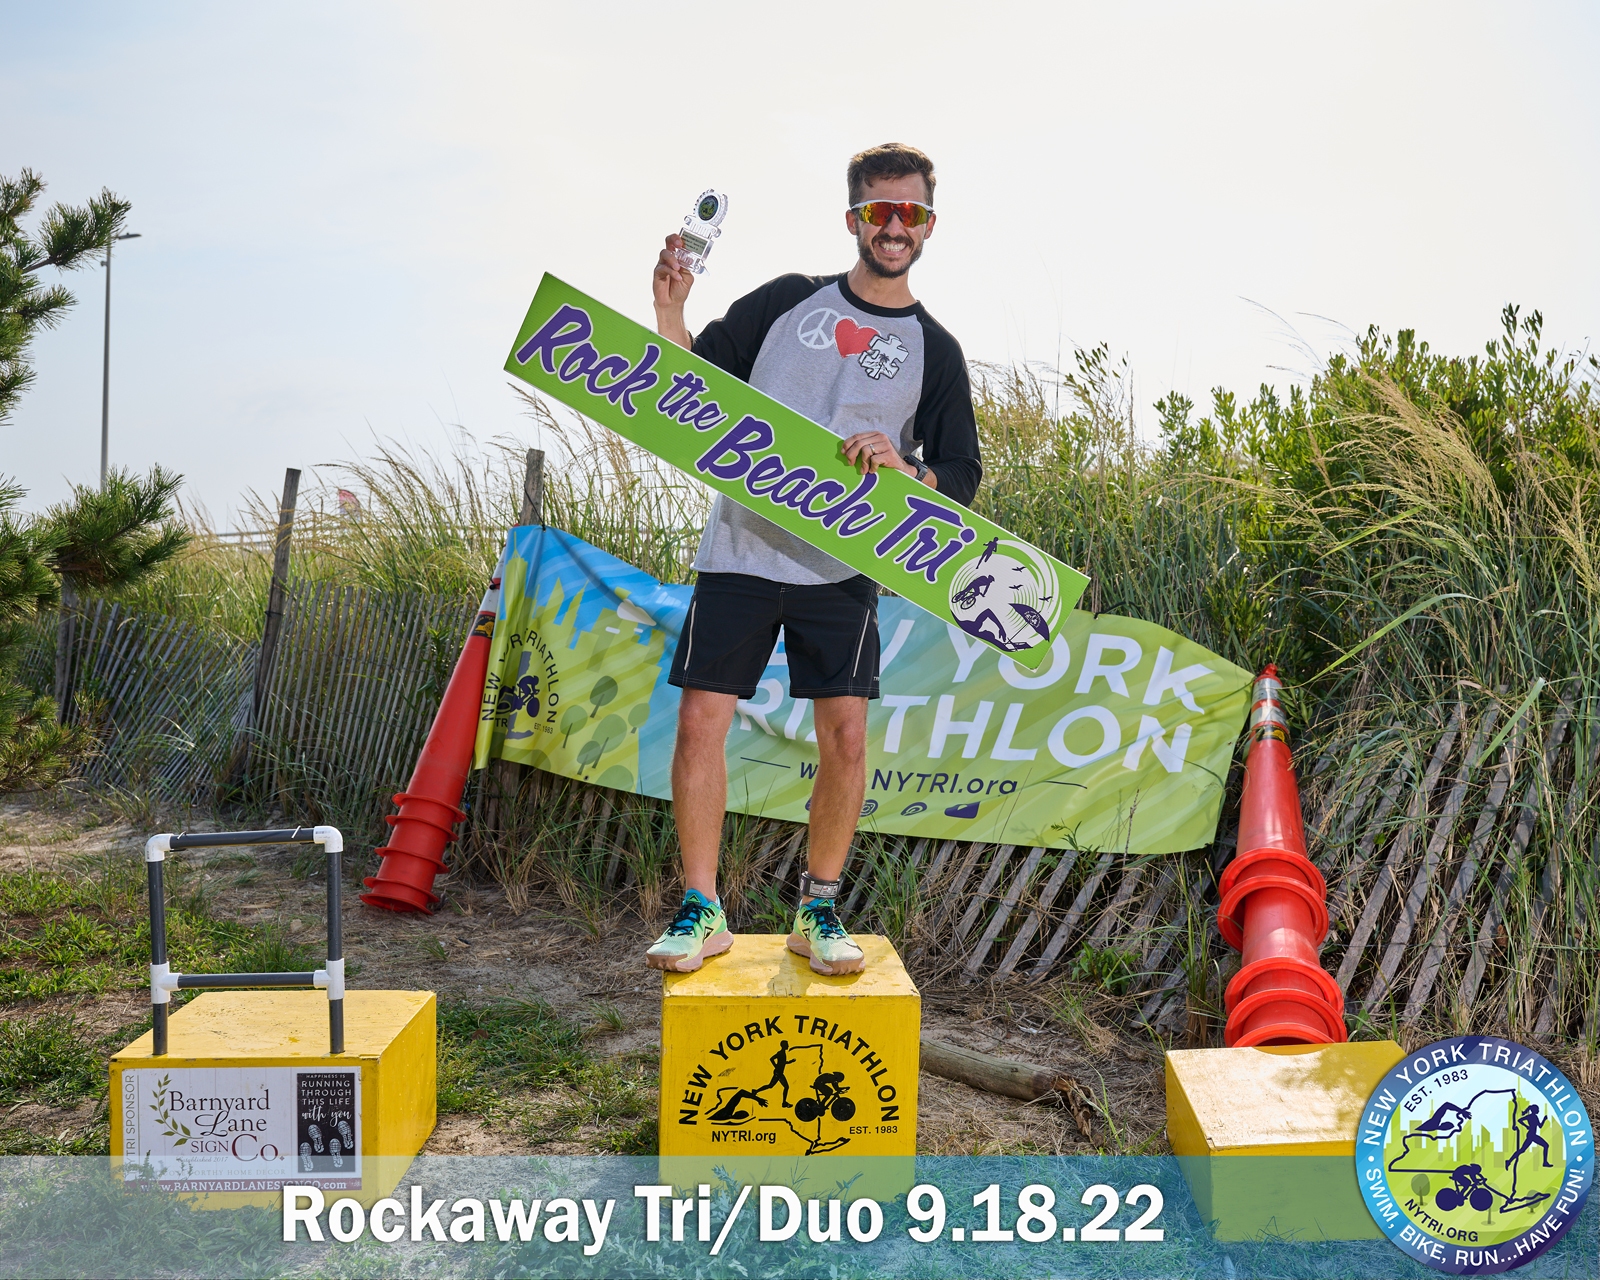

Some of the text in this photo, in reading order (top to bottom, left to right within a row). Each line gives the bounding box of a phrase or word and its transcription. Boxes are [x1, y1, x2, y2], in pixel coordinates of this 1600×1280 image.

[516, 303, 977, 584] Rock the Beach Tri
[482, 672, 501, 721] NEW
[525, 628, 560, 723] RIATHLON
[737, 678, 1192, 773] RITHLON
[678, 1014, 900, 1125] NEW YORK TRIATHLON
[301, 1080, 351, 1088] RUNNING
[301, 1089, 352, 1097] THROUGH
[125, 1075, 136, 1134] SPONSOR
[168, 1089, 271, 1114] Barnyard
[302, 1098, 350, 1106] THIS LIFE
[194, 1110, 267, 1137] Lane
[301, 1105, 352, 1128] with you
[711, 1130, 777, 1144] NYTRI.org
[849, 1125, 898, 1135] EST. 1983
[190, 1140, 229, 1154] SIGN
[231, 1133, 285, 1162] Co.
[255, 1168, 286, 1176] DECOR
